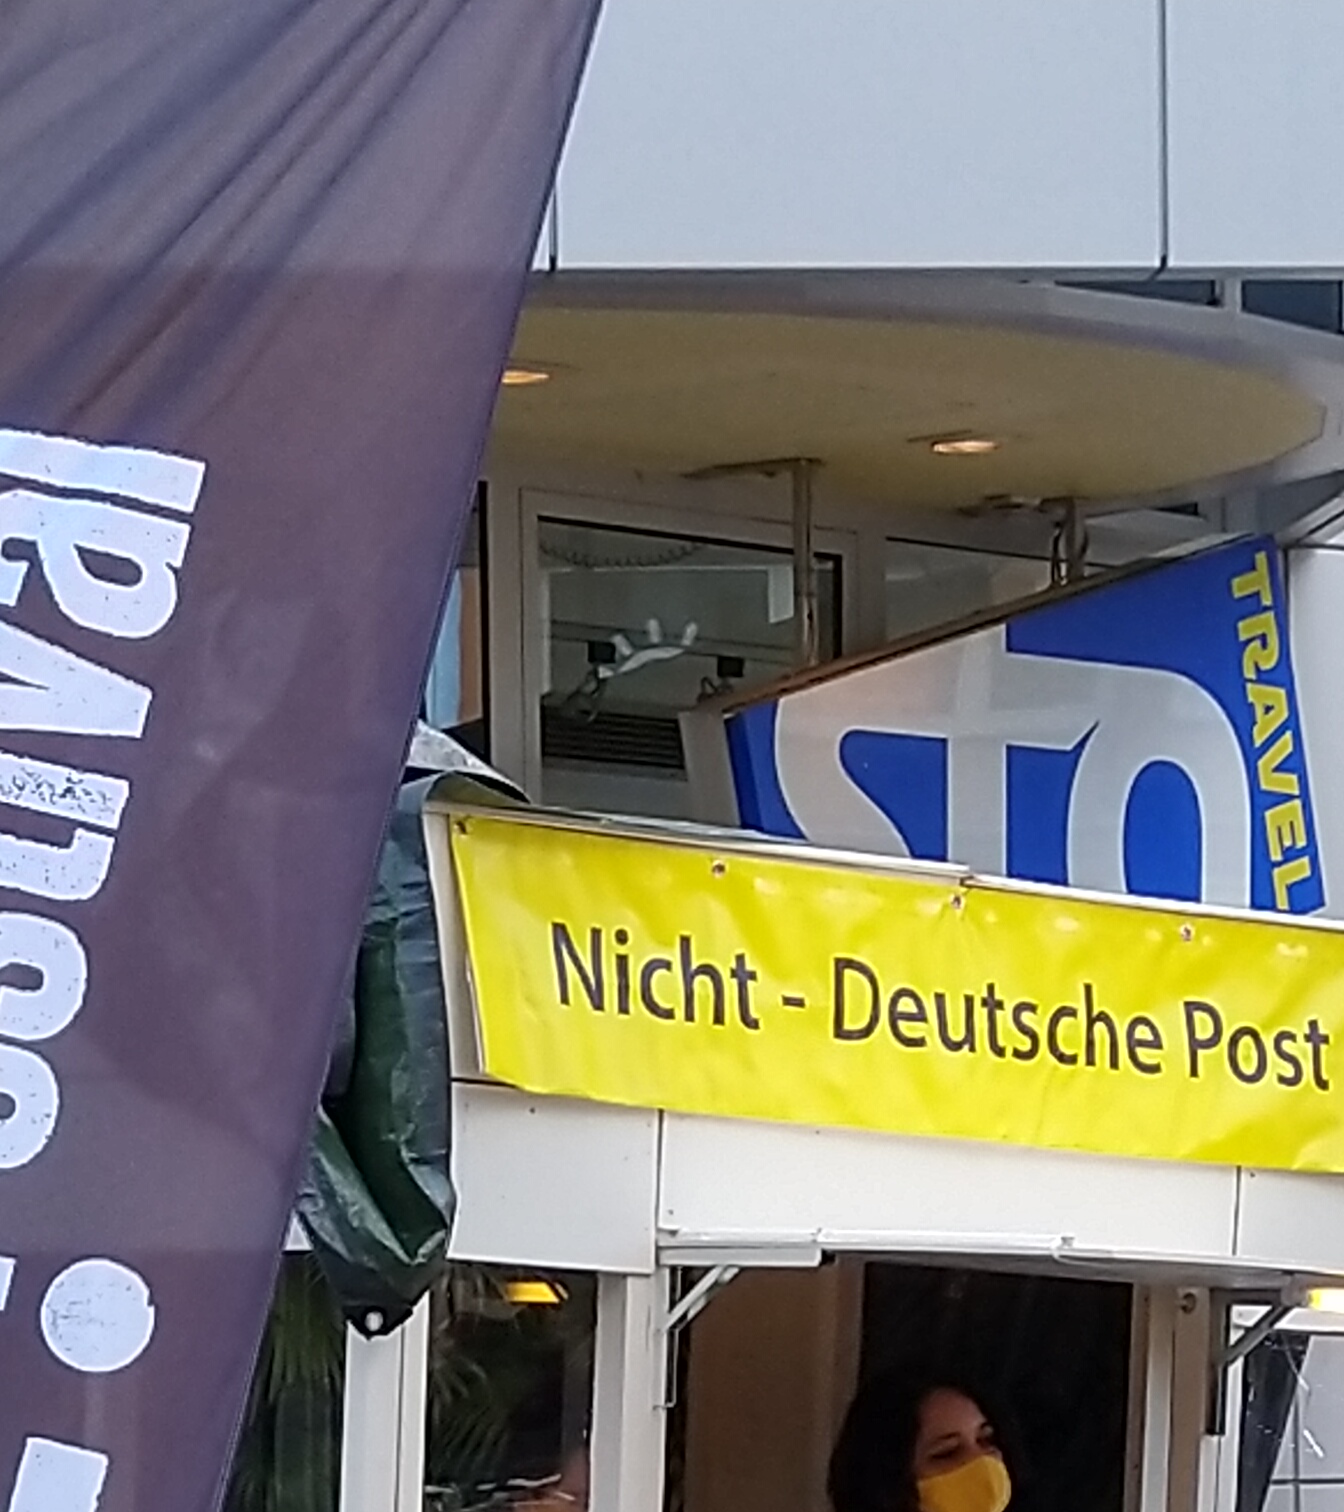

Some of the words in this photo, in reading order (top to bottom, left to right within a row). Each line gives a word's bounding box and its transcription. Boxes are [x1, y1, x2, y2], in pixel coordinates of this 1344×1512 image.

[1230, 550, 1314, 912] TRAVEL
[550, 920, 762, 1031] Nicht
[831, 956, 1164, 1075] Deutsche
[1183, 1000, 1332, 1092] Post
